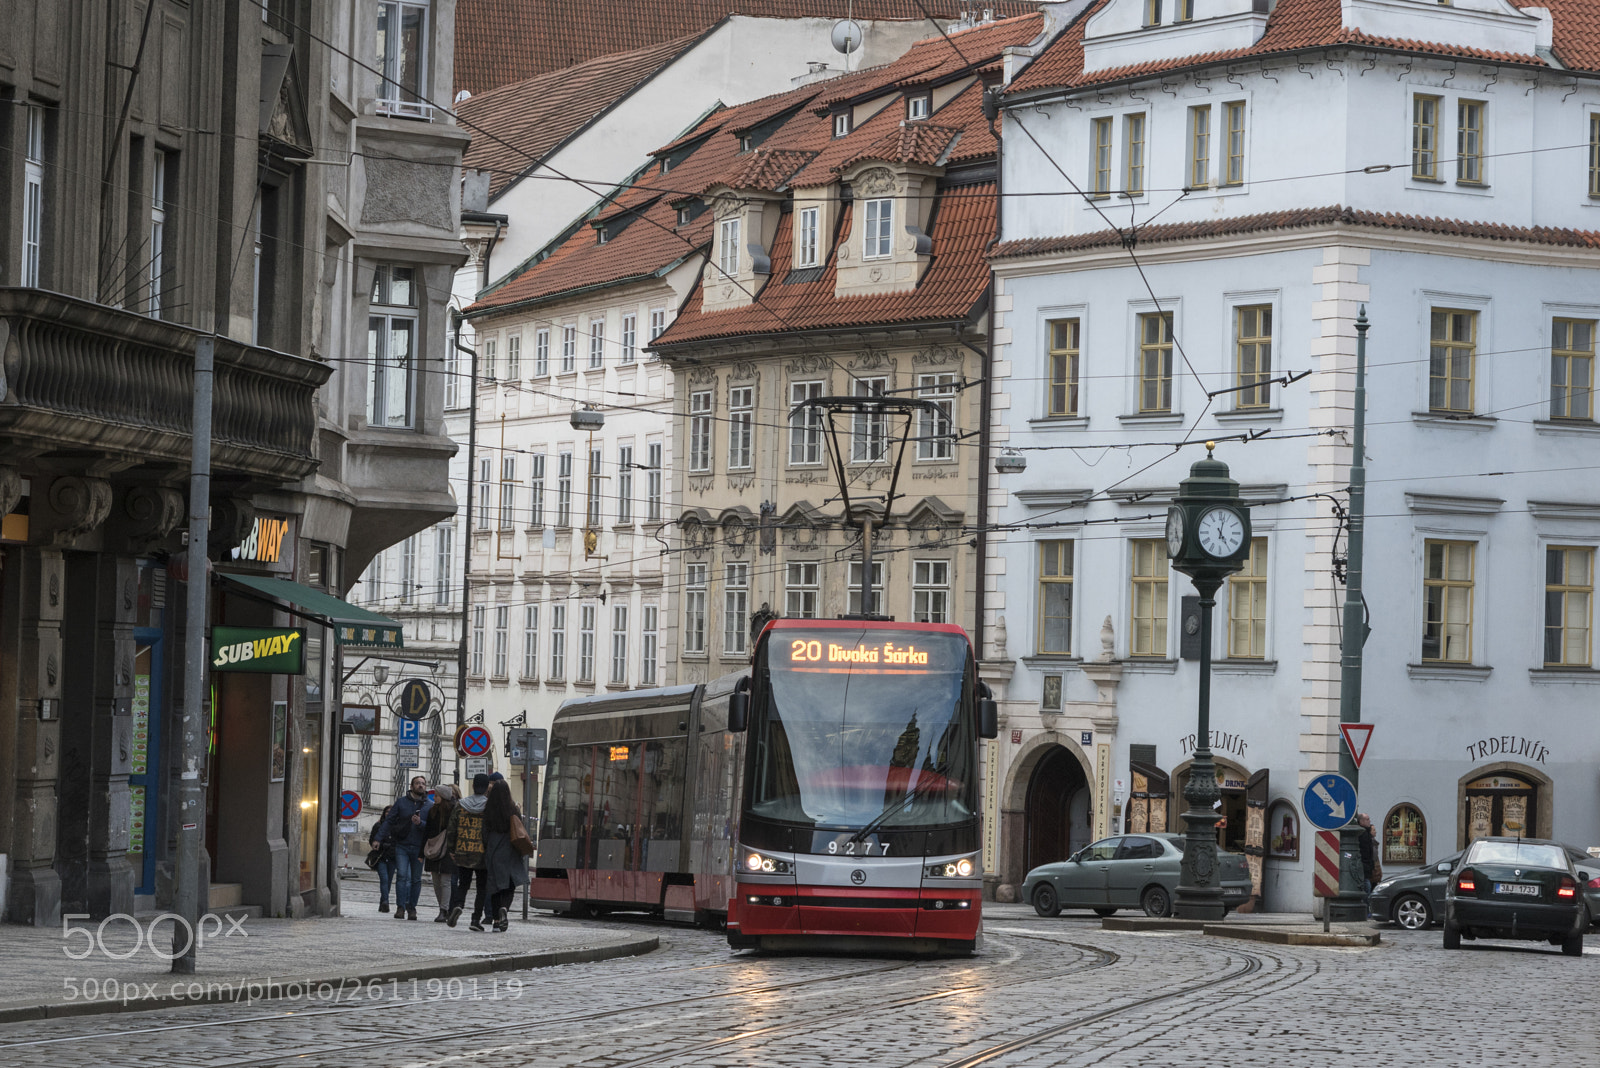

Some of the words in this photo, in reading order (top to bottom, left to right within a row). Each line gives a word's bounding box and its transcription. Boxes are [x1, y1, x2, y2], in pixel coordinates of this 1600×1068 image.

[214, 631, 300, 667] SUBWAY
[791, 639, 822, 661] 20
[828, 643, 879, 663] Divoká
[883, 642, 928, 664] Šárka
[1180, 730, 1248, 758] TRELNÍK
[1466, 736, 1550, 764] TRDELNÍK
[828, 841, 891, 856] 9277
[1500, 884, 1514, 892] 3AJ
[1519, 885, 1537, 894] 1733
